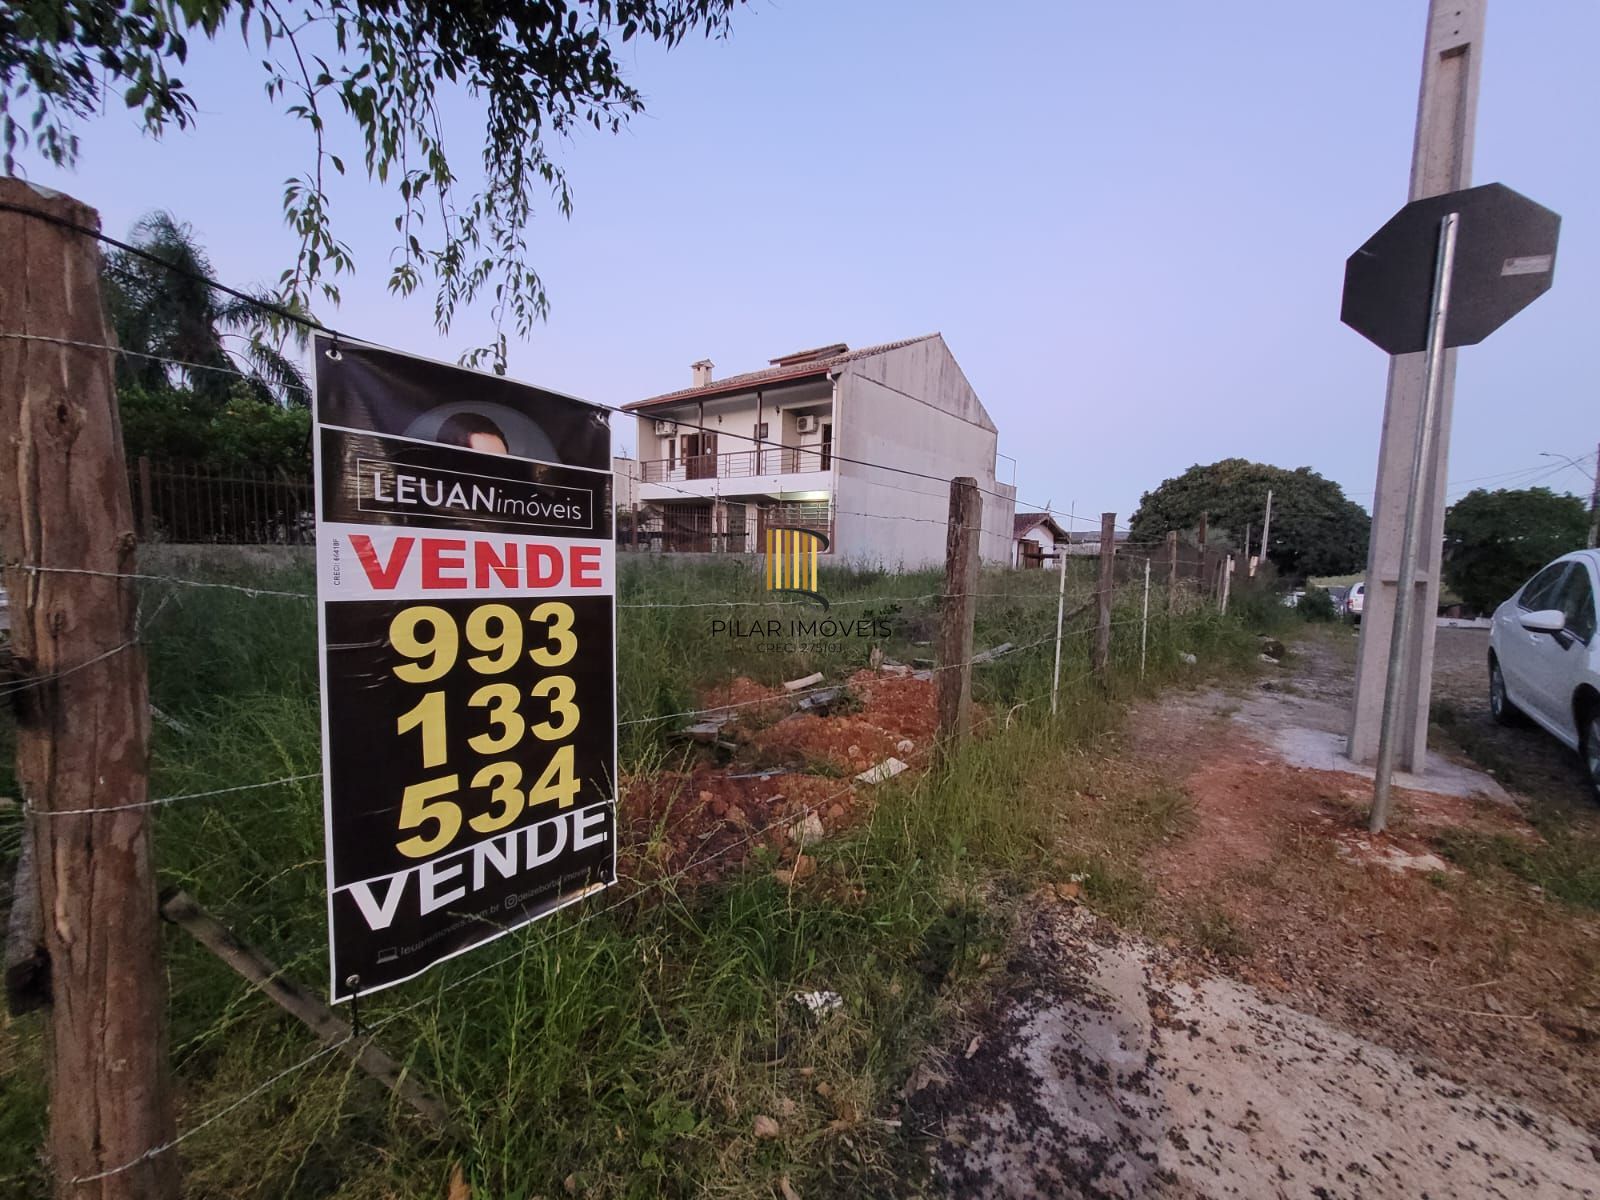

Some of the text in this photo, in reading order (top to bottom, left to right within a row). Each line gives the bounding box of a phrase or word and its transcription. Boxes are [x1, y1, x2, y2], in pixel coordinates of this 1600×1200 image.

[348, 534, 602, 589] VENDE
[389, 602, 578, 683] 993
[397, 675, 581, 769] 133
[395, 745, 581, 858] 534
